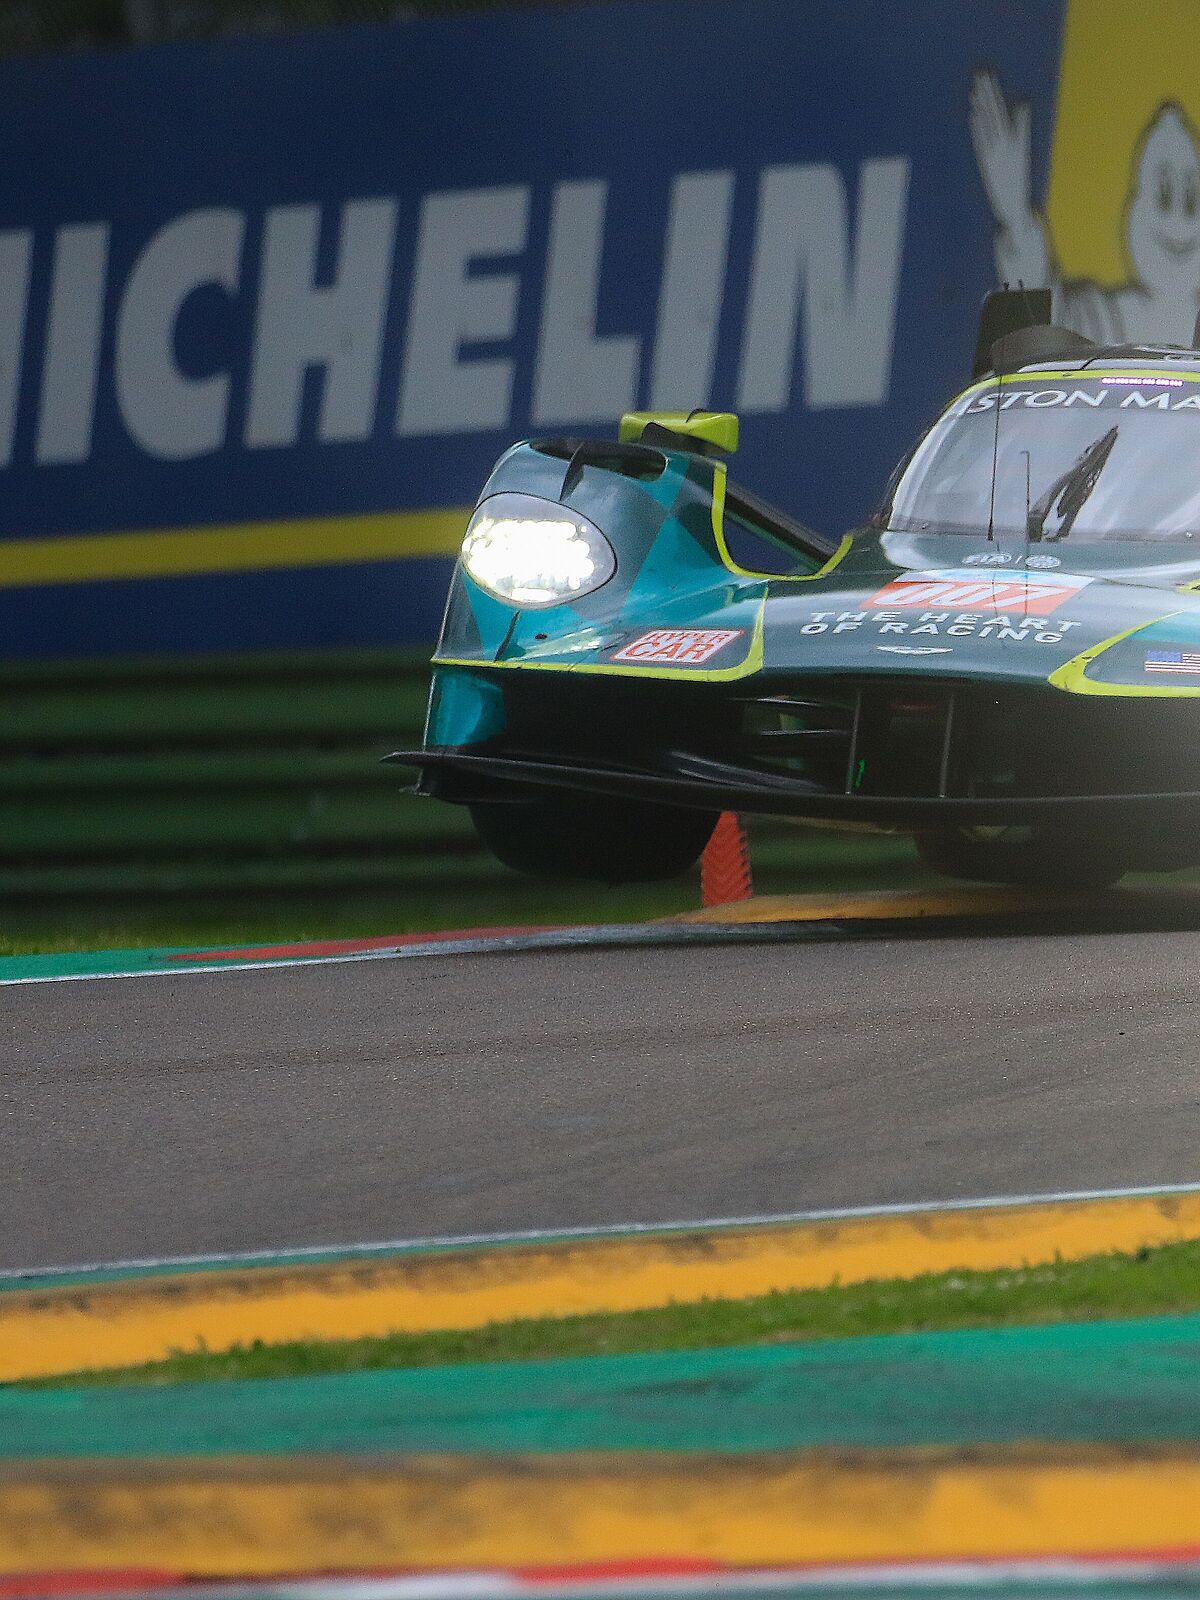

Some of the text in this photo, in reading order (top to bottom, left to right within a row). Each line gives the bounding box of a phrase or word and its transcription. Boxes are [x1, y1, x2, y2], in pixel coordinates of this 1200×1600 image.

[957, 389, 1109, 413] STON
[873, 583, 1068, 608] 007
[810, 611, 1082, 632] THE HEART
[800, 622, 1064, 644] OF RACING
[625, 641, 715, 660] CAR
